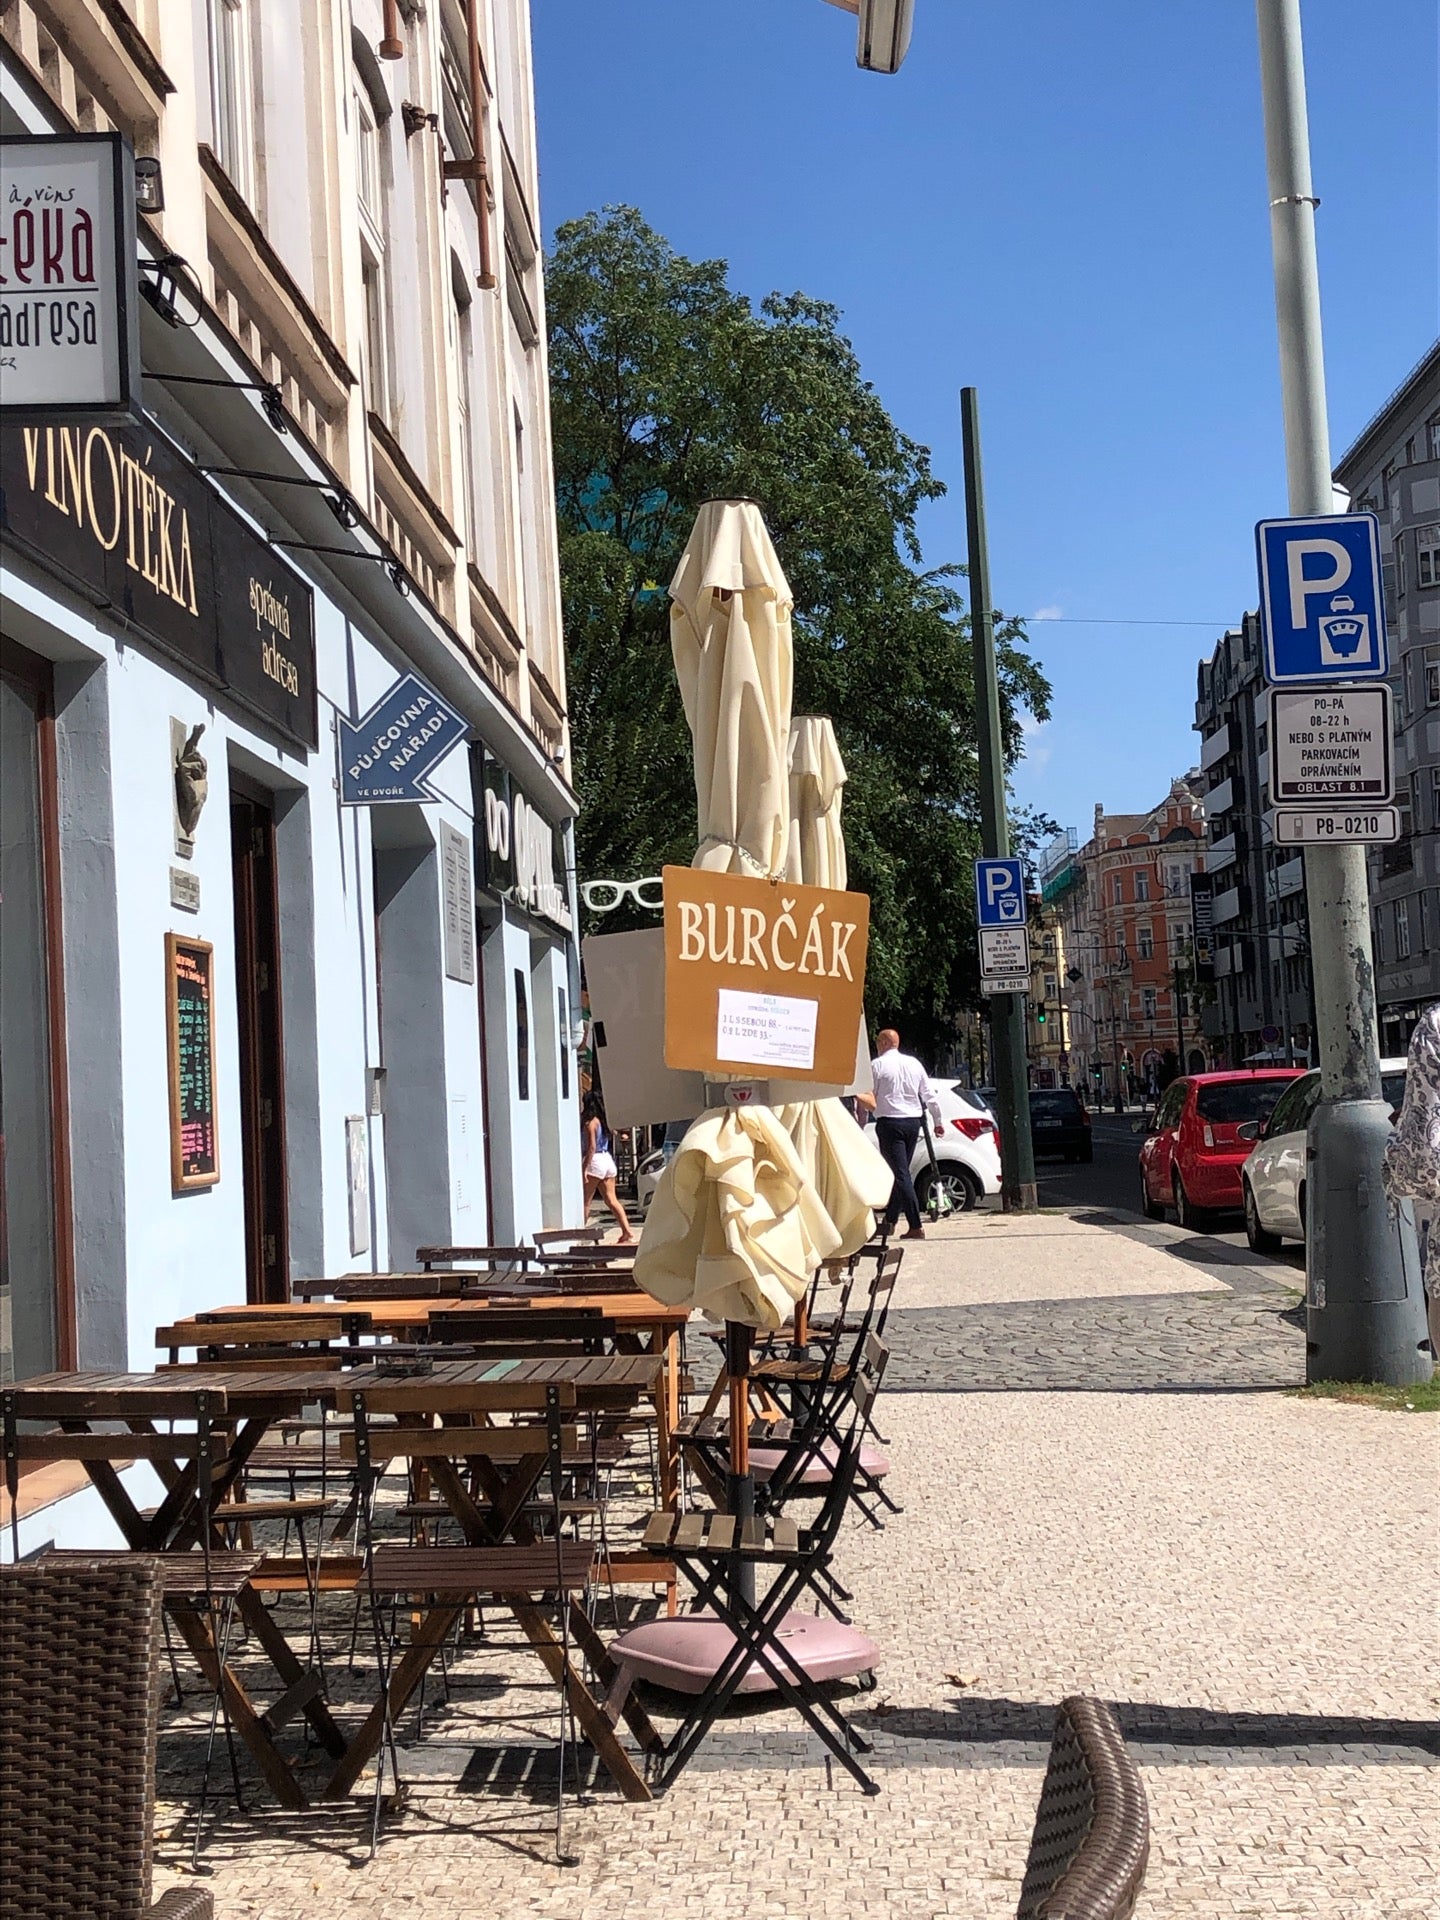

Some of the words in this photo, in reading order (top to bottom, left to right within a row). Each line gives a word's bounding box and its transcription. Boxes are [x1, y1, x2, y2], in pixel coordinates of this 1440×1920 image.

[0, 301, 97, 347] adresa
[23, 427, 199, 617] VINOTÉKA
[1286, 538, 1352, 630] P
[249, 576, 291, 640] správná
[261, 632, 299, 697] adresa
[1310, 715, 1341, 727] 08-22
[1343, 715, 1350, 726] h
[1314, 695, 1345, 710] PO-PÁ
[348, 695, 433, 781] PŮJČOVNA
[388, 707, 450, 773] NÁŘADÍ
[1289, 732, 1314, 744] NEBO
[1318, 732, 1325, 743] S
[1329, 727, 1372, 743] PLATNÝM
[1301, 746, 1360, 761] PARKOVACÍM
[1297, 782, 1343, 793] OBLAST
[1349, 781, 1365, 792] 8.1
[1301, 762, 1361, 777] OPRÁVNĚNÍM
[373, 786, 405, 796] DVOŘE
[1316, 816, 1379, 835] P8-0210
[986, 867, 1013, 905] P
[677, 897, 857, 982] BURČÁK
